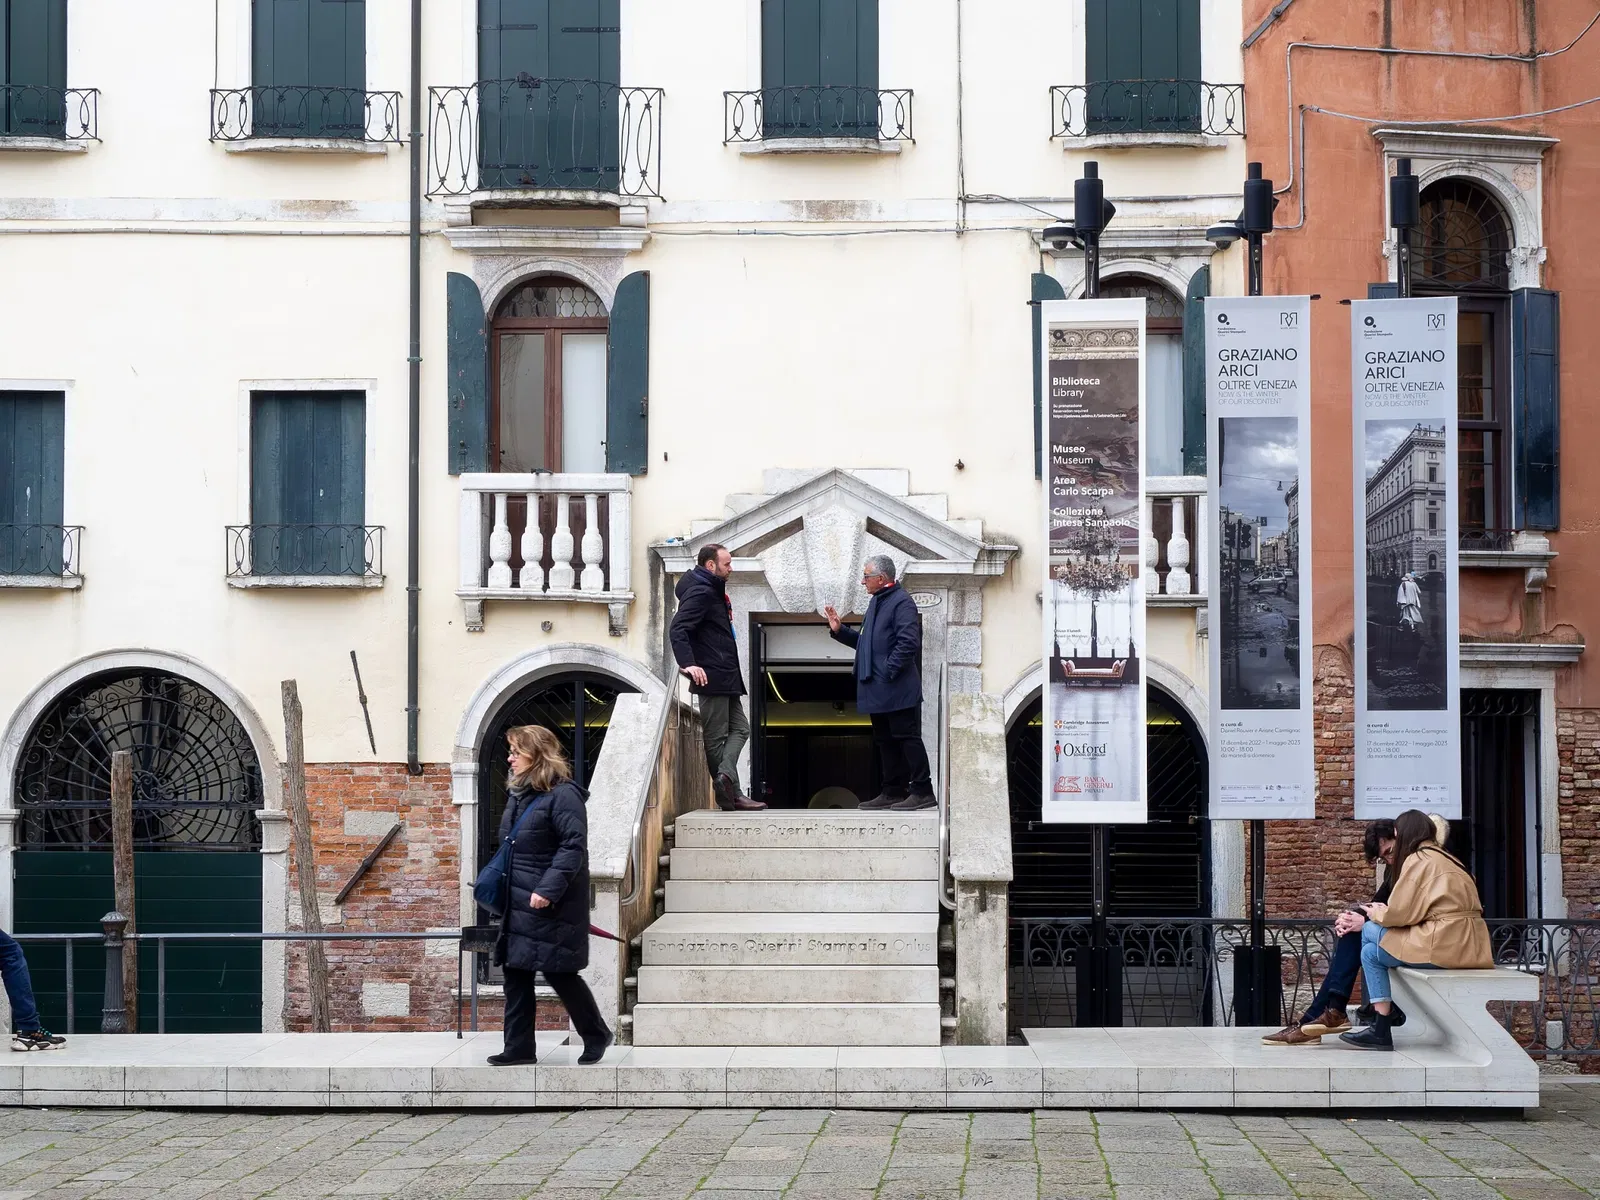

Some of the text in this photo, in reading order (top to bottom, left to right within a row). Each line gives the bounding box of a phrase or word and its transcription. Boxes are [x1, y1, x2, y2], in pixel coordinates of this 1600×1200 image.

[1218, 348, 1297, 361] GRAZIANO
[1365, 350, 1445, 364] GRAZIANO
[1218, 364, 1258, 377] ARICI
[1365, 366, 1405, 379] ARICI
[1053, 377, 1100, 385] Biblioteca
[1218, 380, 1297, 390] OLTRE VENEZIA
[1365, 381, 1445, 392] OLTRE VENEZIA
[1053, 389, 1084, 398] Library
[1053, 445, 1085, 453] Museo
[1053, 456, 1093, 464] Museum
[1054, 487, 1114, 498] Carlo Scarpa
[1053, 507, 1103, 516] Collezione
[1053, 518, 1130, 528] Intesa Sanpaolo
[1064, 742, 1106, 757] Oxford
[680, 823, 934, 838] Fondazione Querini Stampalia Onlus
[649, 939, 931, 953] Fondazione Querini Stampalia Onlus
